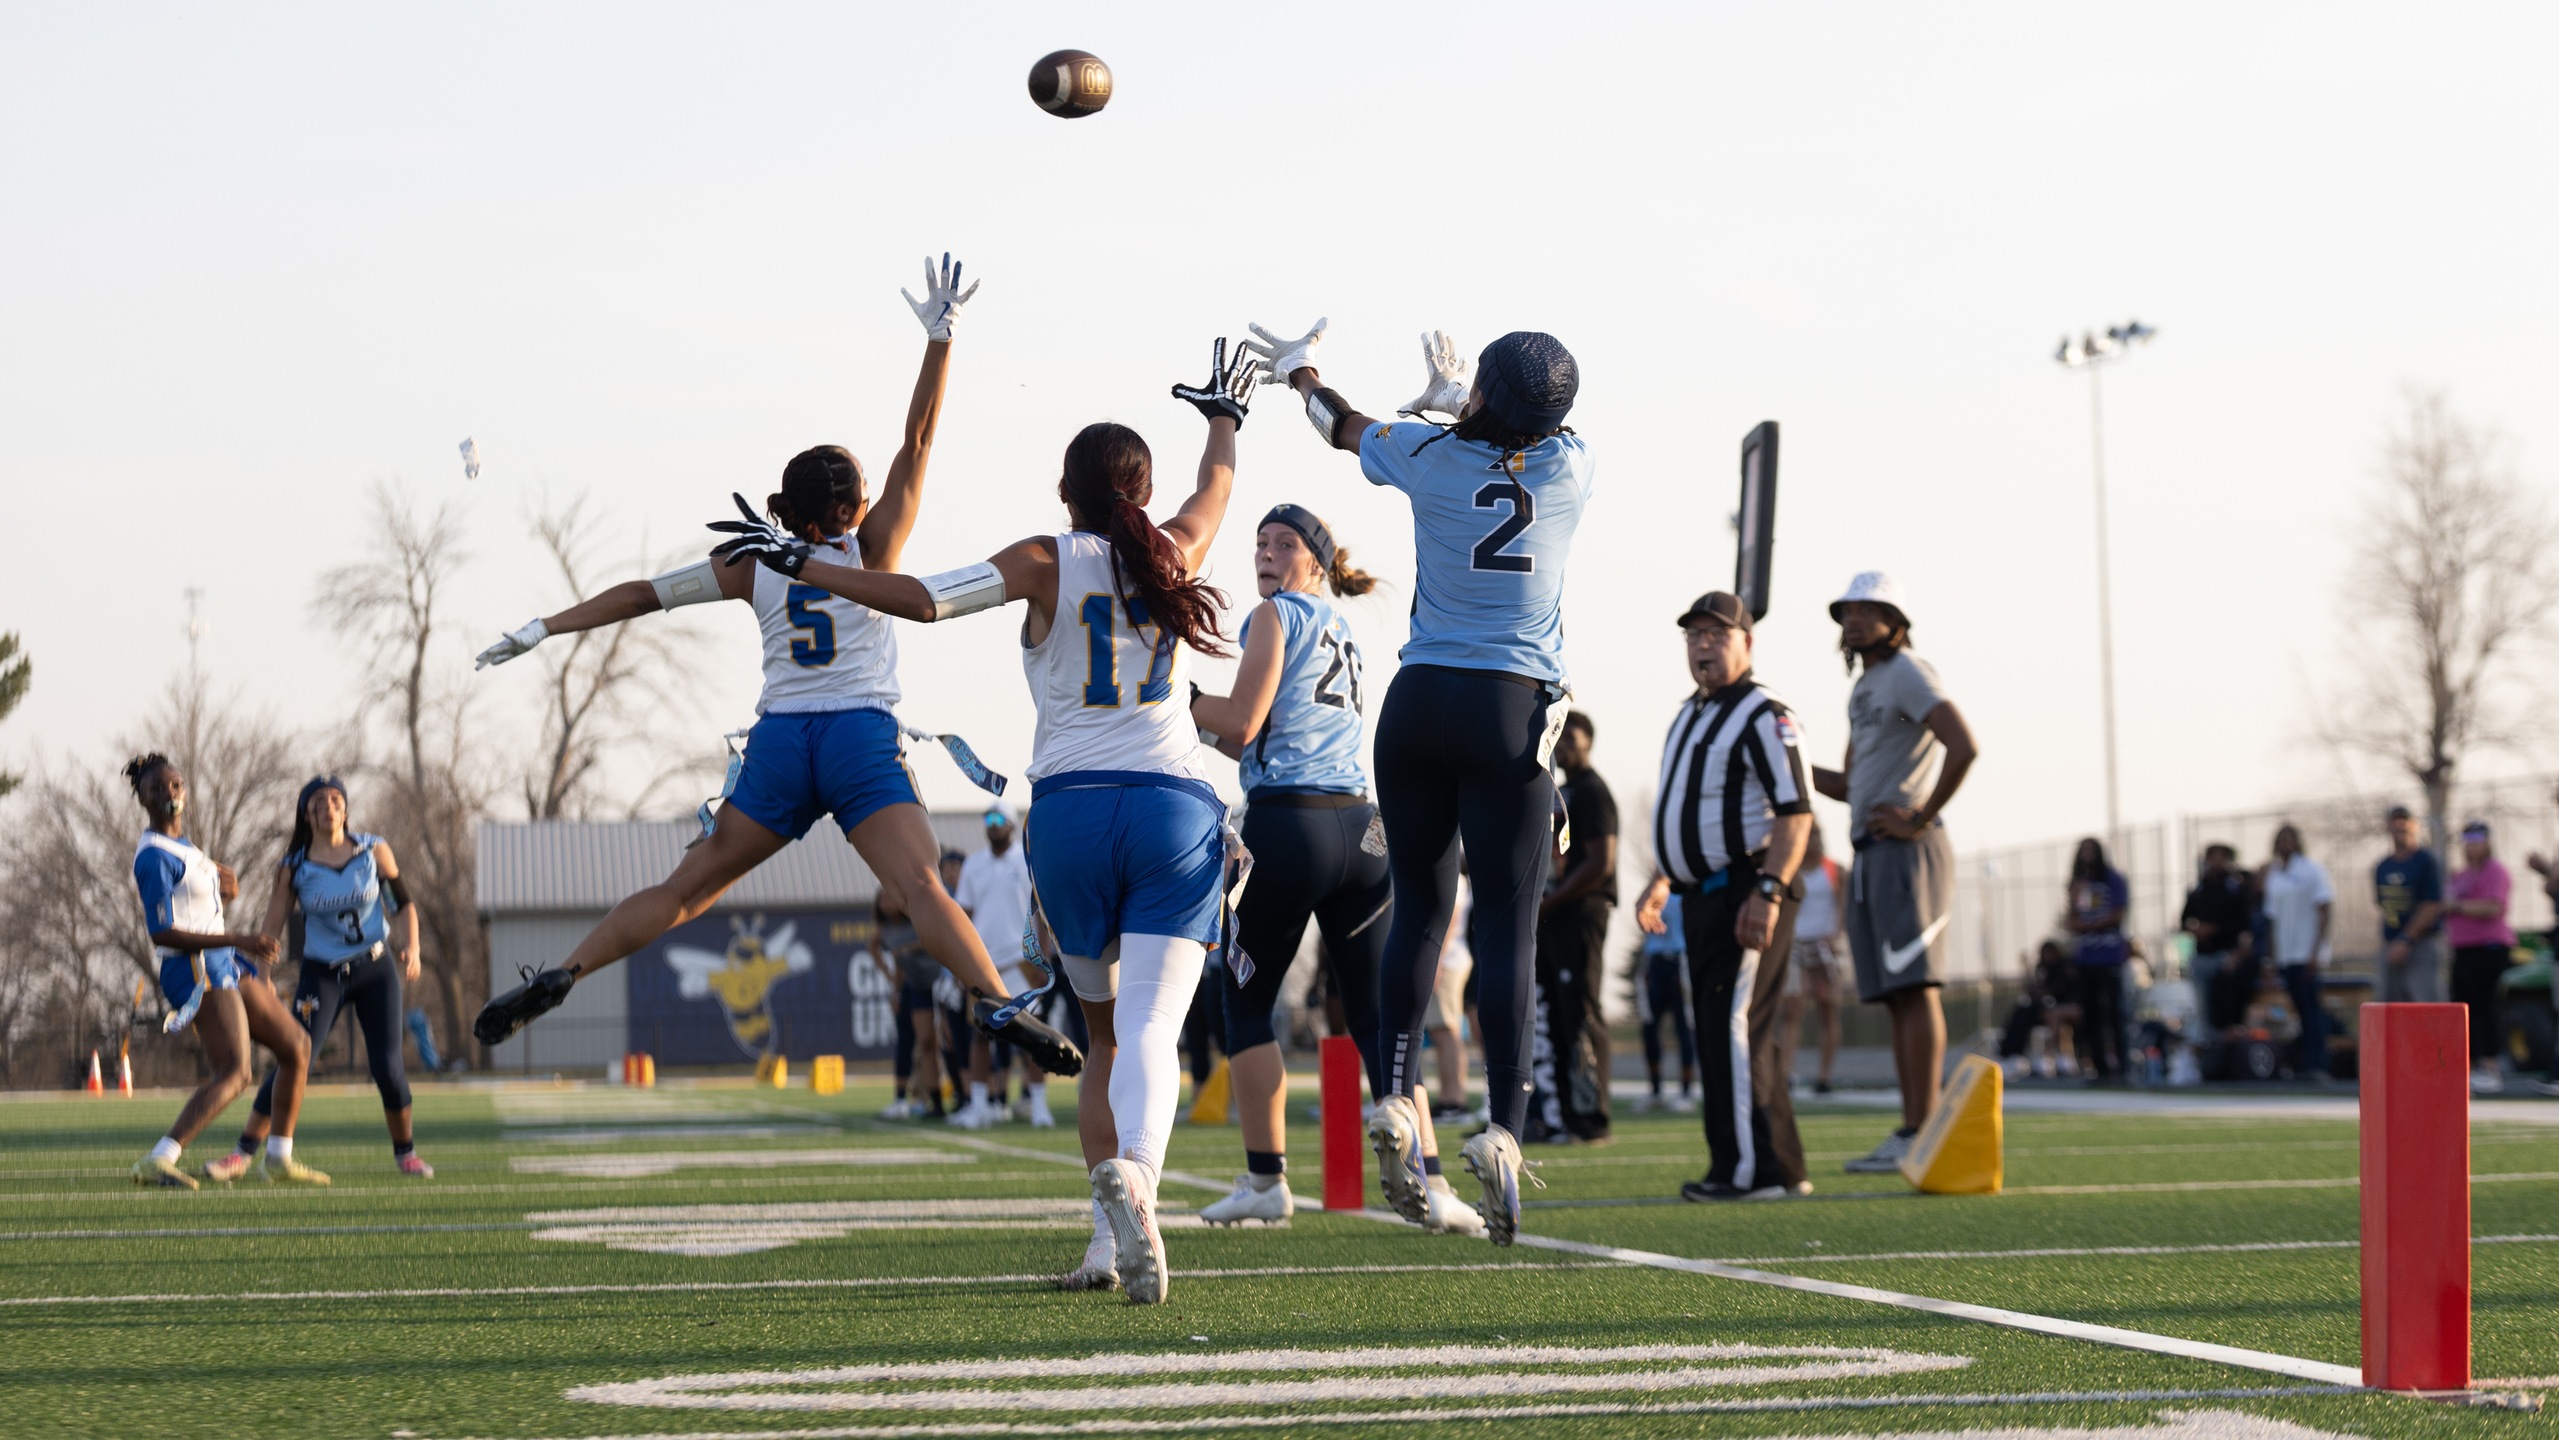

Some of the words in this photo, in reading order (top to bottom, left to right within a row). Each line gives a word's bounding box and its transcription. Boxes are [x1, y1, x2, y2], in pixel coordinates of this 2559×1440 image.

[1470, 480, 1537, 575] 2
[785, 580, 838, 668] 5
[1078, 592, 1176, 709] 17
[336, 907, 365, 946] 3
